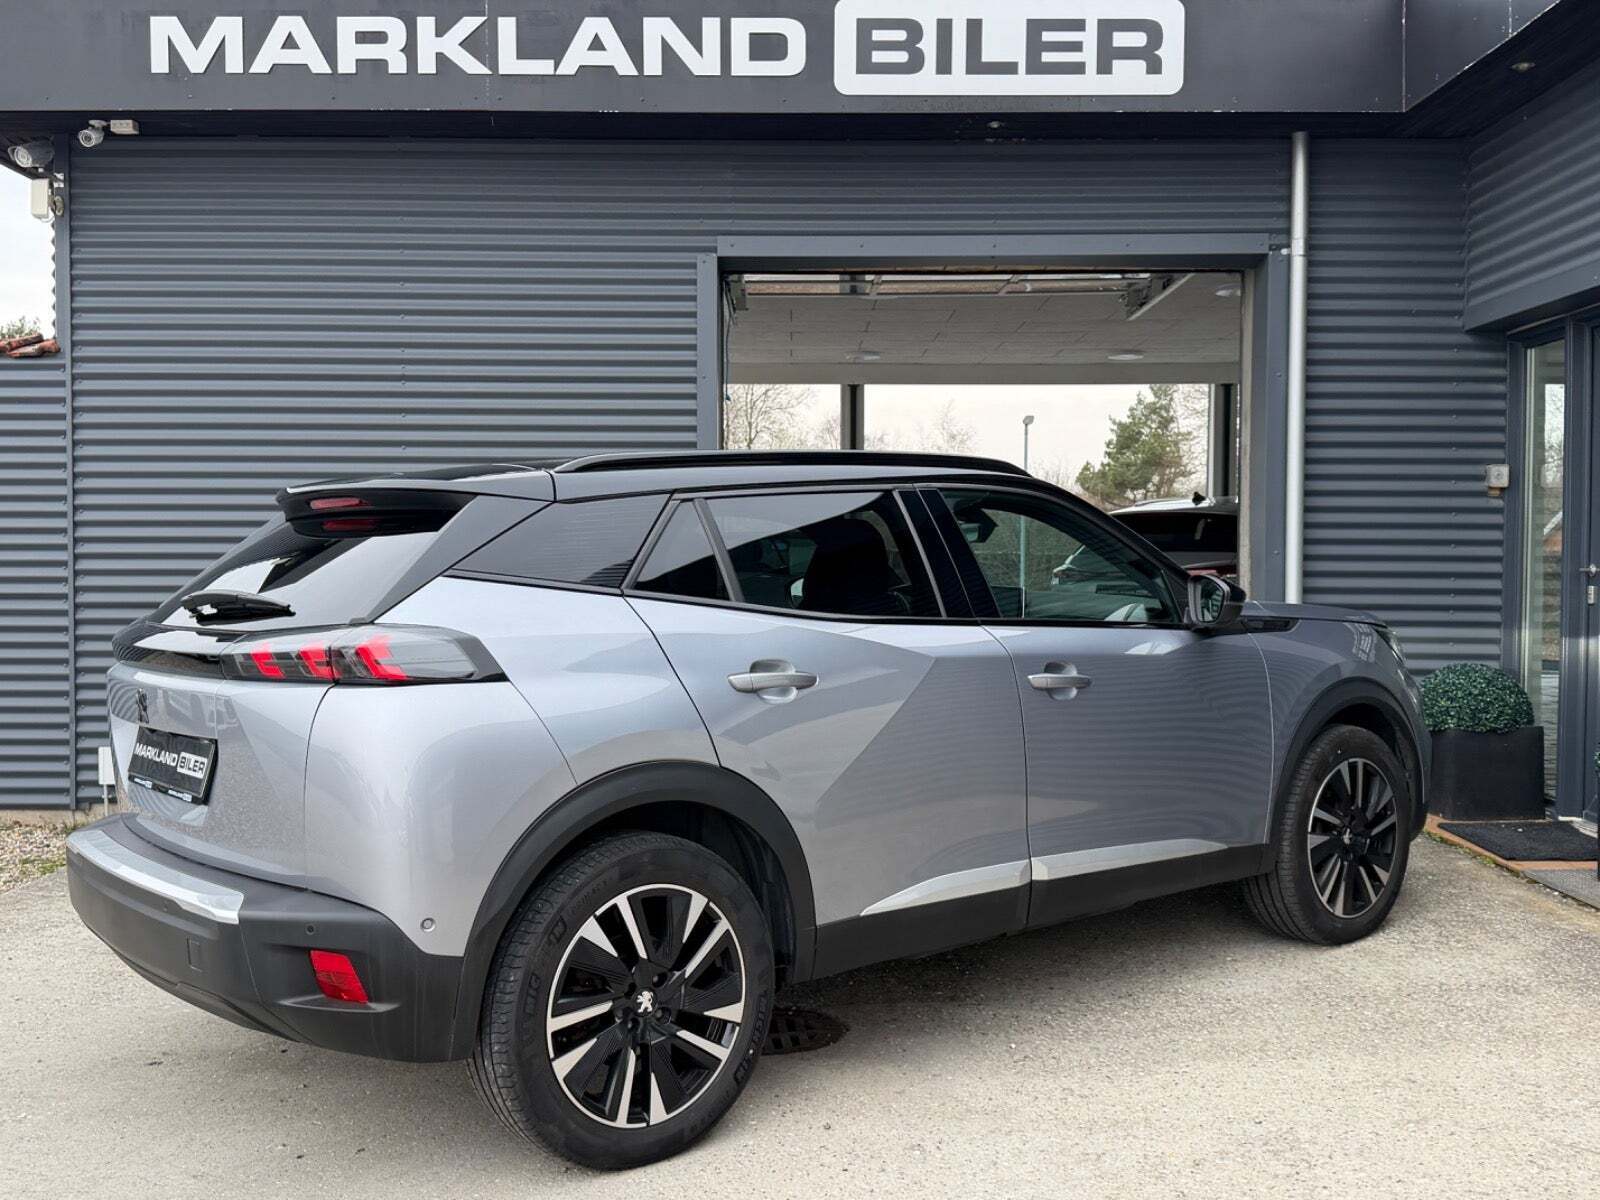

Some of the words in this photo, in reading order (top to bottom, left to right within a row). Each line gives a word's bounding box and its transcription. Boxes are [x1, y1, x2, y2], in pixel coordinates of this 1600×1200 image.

[150, 15, 807, 77] MARKLAND
[855, 17, 1164, 75] BILER
[134, 742, 178, 767] MARKLAND
[179, 756, 205, 776] BILER
